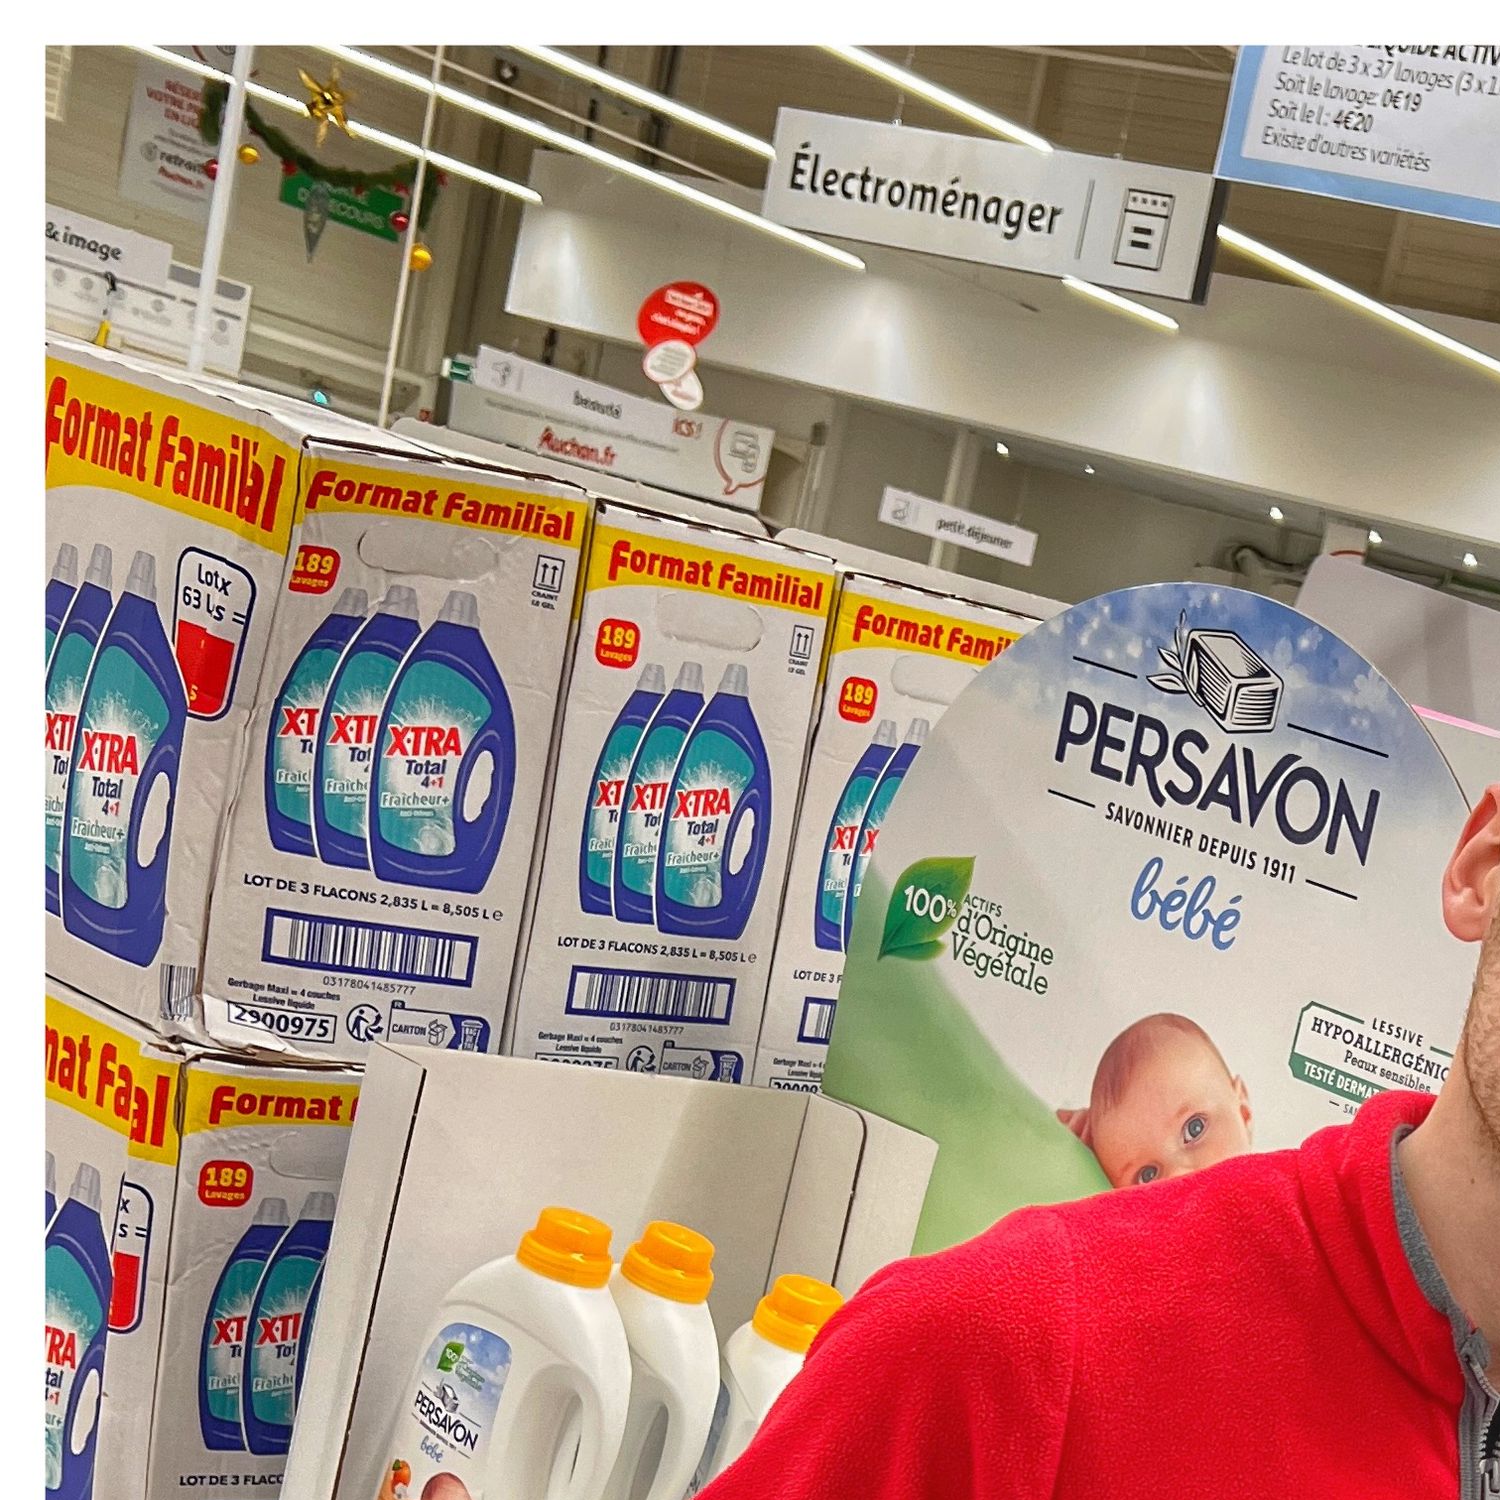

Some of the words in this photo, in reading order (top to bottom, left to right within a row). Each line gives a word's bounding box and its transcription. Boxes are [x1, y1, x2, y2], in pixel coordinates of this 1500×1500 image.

[1275, 71, 1305, 94] Soit
[1381, 88, 1423, 112] 0€19
[1267, 98, 1299, 121] Soit
[1333, 109, 1374, 133] 4€20
[789, 143, 1063, 241] Électroménager
[63, 228, 122, 261] image
[45, 376, 149, 483] Format
[306, 470, 439, 516] Format
[442, 491, 575, 542] Familial
[296, 551, 333, 575] 189
[608, 540, 713, 587] Format
[718, 566, 824, 611] Familial
[853, 605, 942, 651] Format
[405, 759, 447, 776] Total
[1054, 691, 1381, 867] PERSAVON
[1105, 802, 1193, 849] SAVONNIER
[1199, 834, 1257, 869] DEPUIS
[1262, 855, 1296, 884] 1911
[244, 873, 271, 889] LOT
[275, 877, 297, 893] DE
[300, 881, 310, 894] 3
[313, 884, 377, 903] FLACONS
[381, 893, 418, 911] 2,835
[420, 899, 429, 911] L
[443, 902, 479, 919] 8,505
[903, 885, 957, 924] 100%
[963, 893, 1003, 918] ACTIFS
[1130, 857, 1243, 951] bébé
[956, 907, 1055, 968] d'Origine
[951, 934, 1050, 996] Végétale
[234, 1006, 329, 1038] 2900975
[392, 1022, 427, 1036] CARTON
[1372, 1018, 1424, 1048] LESSIVE
[1344, 1050, 1378, 1074] Peaux
[1380, 1066, 1431, 1094] sensibles
[209, 1085, 342, 1126] Format
[205, 1166, 247, 1188] 189
[413, 1388, 479, 1452] PERSAVON
